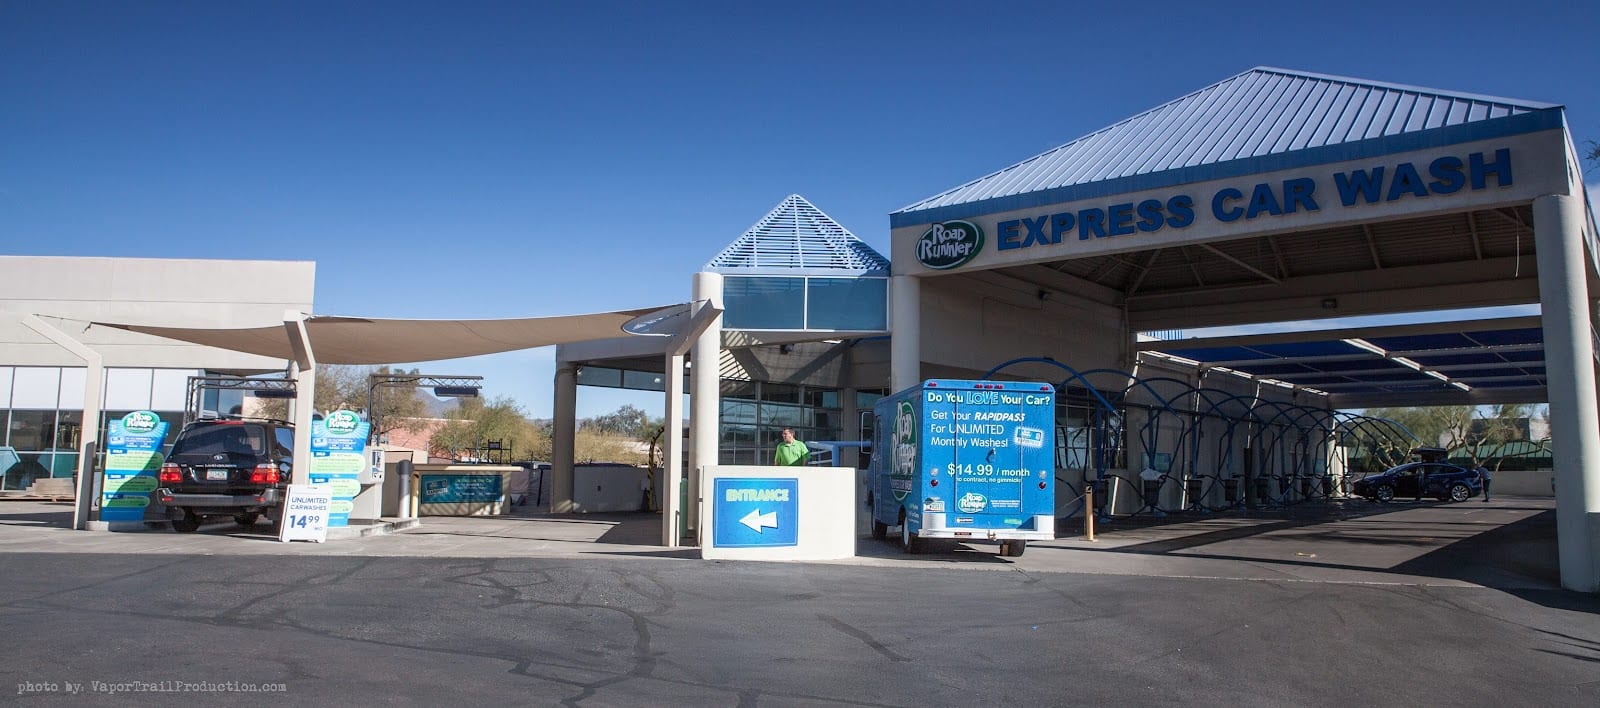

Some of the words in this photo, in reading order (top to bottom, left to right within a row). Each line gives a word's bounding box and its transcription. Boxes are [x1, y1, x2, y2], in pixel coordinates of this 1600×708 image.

[997, 195, 1196, 251] EXPRESS
[1211, 176, 1319, 223] CAR
[1333, 148, 1513, 207] WASH
[927, 392, 943, 402] Do
[945, 393, 964, 403] You
[966, 391, 999, 405] LOVE
[1001, 394, 1022, 405] Your
[1026, 395, 1051, 405] Car?
[931, 410, 948, 420] Get
[951, 411, 972, 421] Your
[974, 412, 1026, 422] RAPIDPASS
[931, 424, 946, 433] For
[948, 424, 1005, 435] UNLIMITED
[931, 437, 968, 448] Monthly
[971, 437, 1009, 447] Washes!
[947, 462, 994, 477] $14.99
[1001, 468, 1031, 477] month
[725, 488, 790, 502] ENTRANCE
